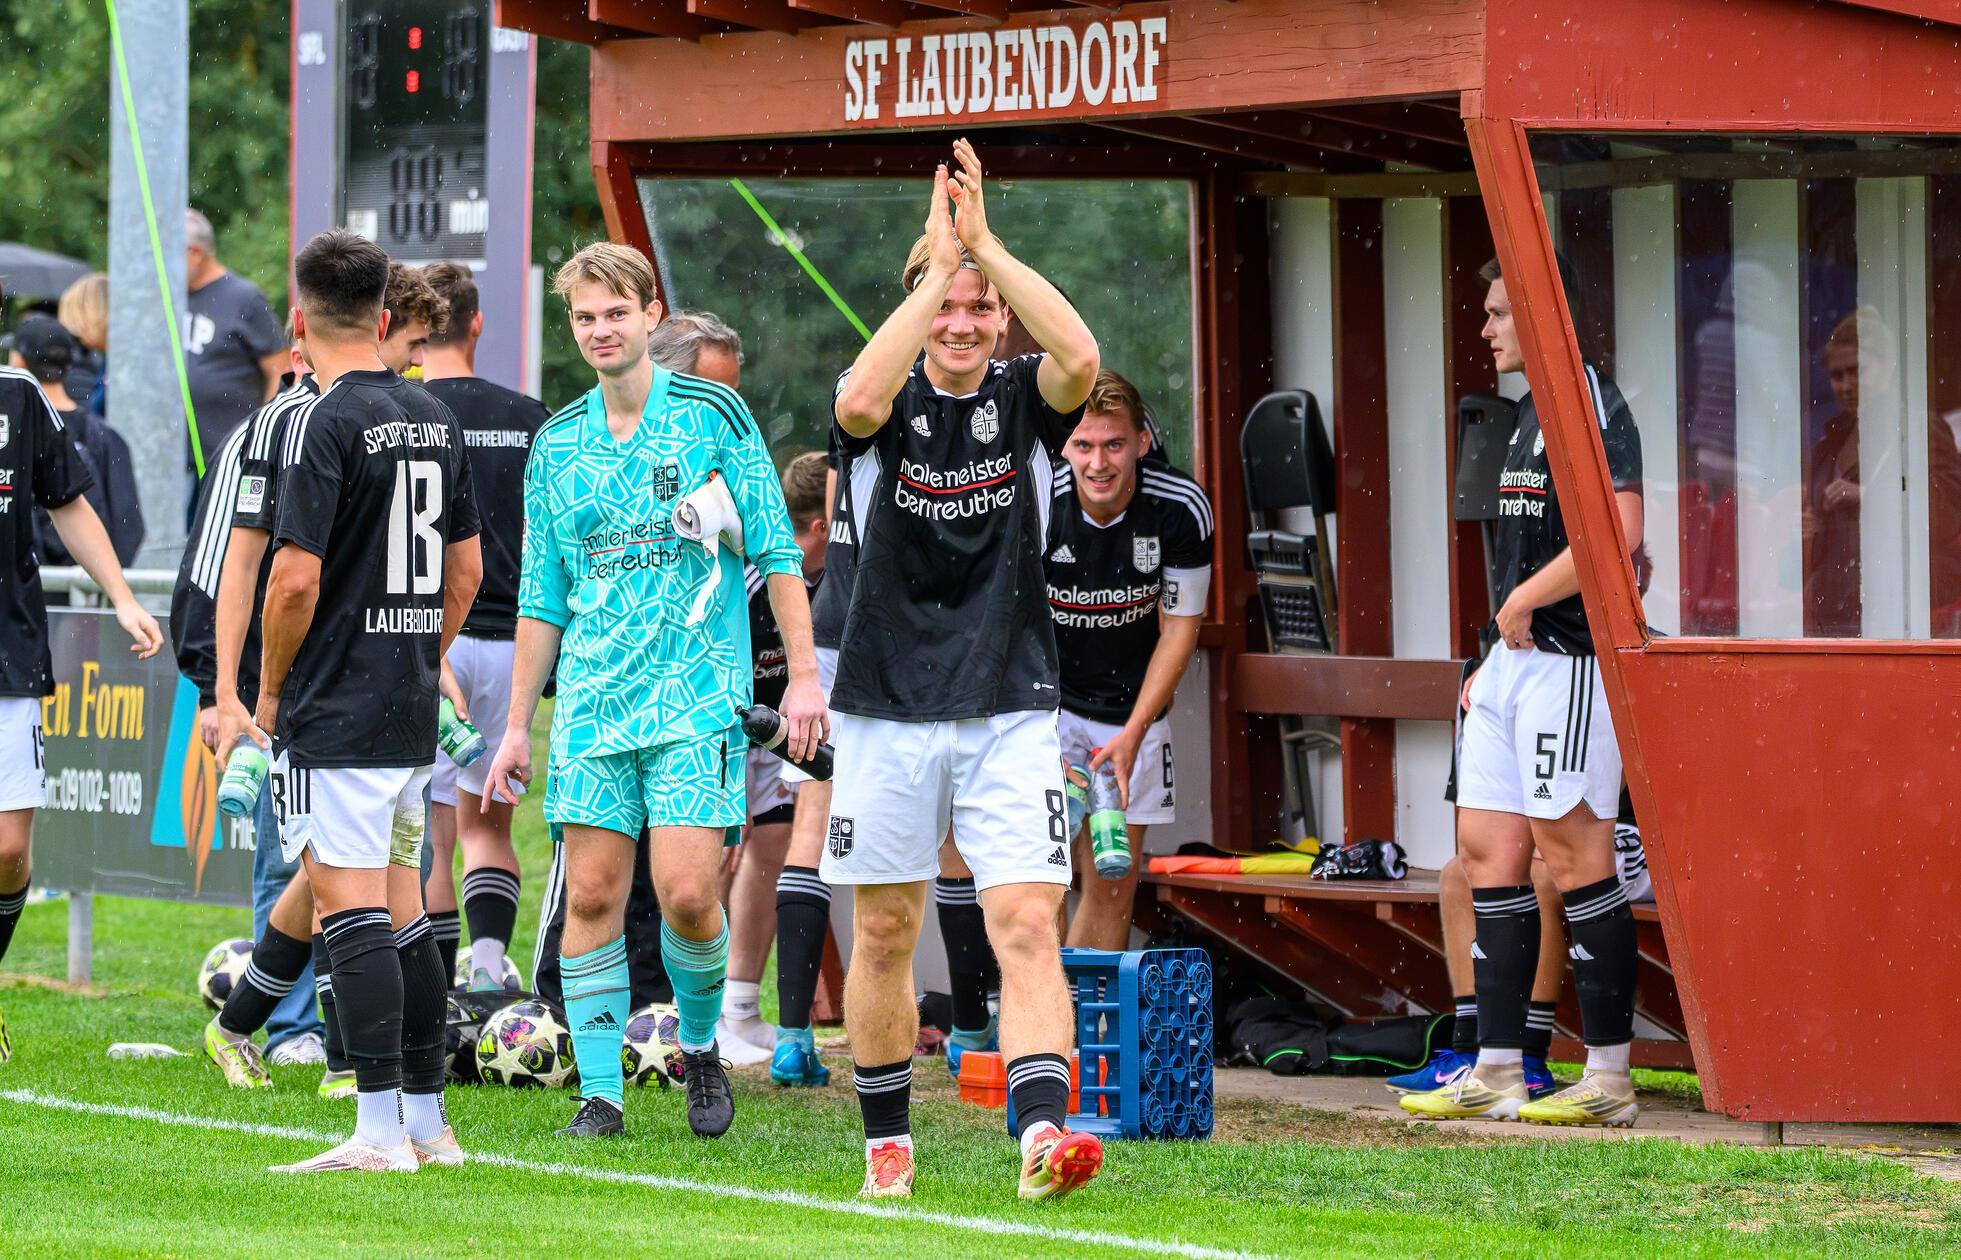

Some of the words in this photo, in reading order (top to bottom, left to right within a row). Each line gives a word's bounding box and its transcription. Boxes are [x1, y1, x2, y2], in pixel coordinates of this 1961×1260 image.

[845, 40, 888, 121] SF
[895, 17, 1167, 118] LAUBENDORF
[387, 460, 443, 595] 18
[77, 661, 145, 740] Form
[1163, 743, 1174, 788] 6
[1535, 733, 1558, 779] 5
[1045, 789, 1067, 843] 8
[578, 1023, 621, 1032] adidas
